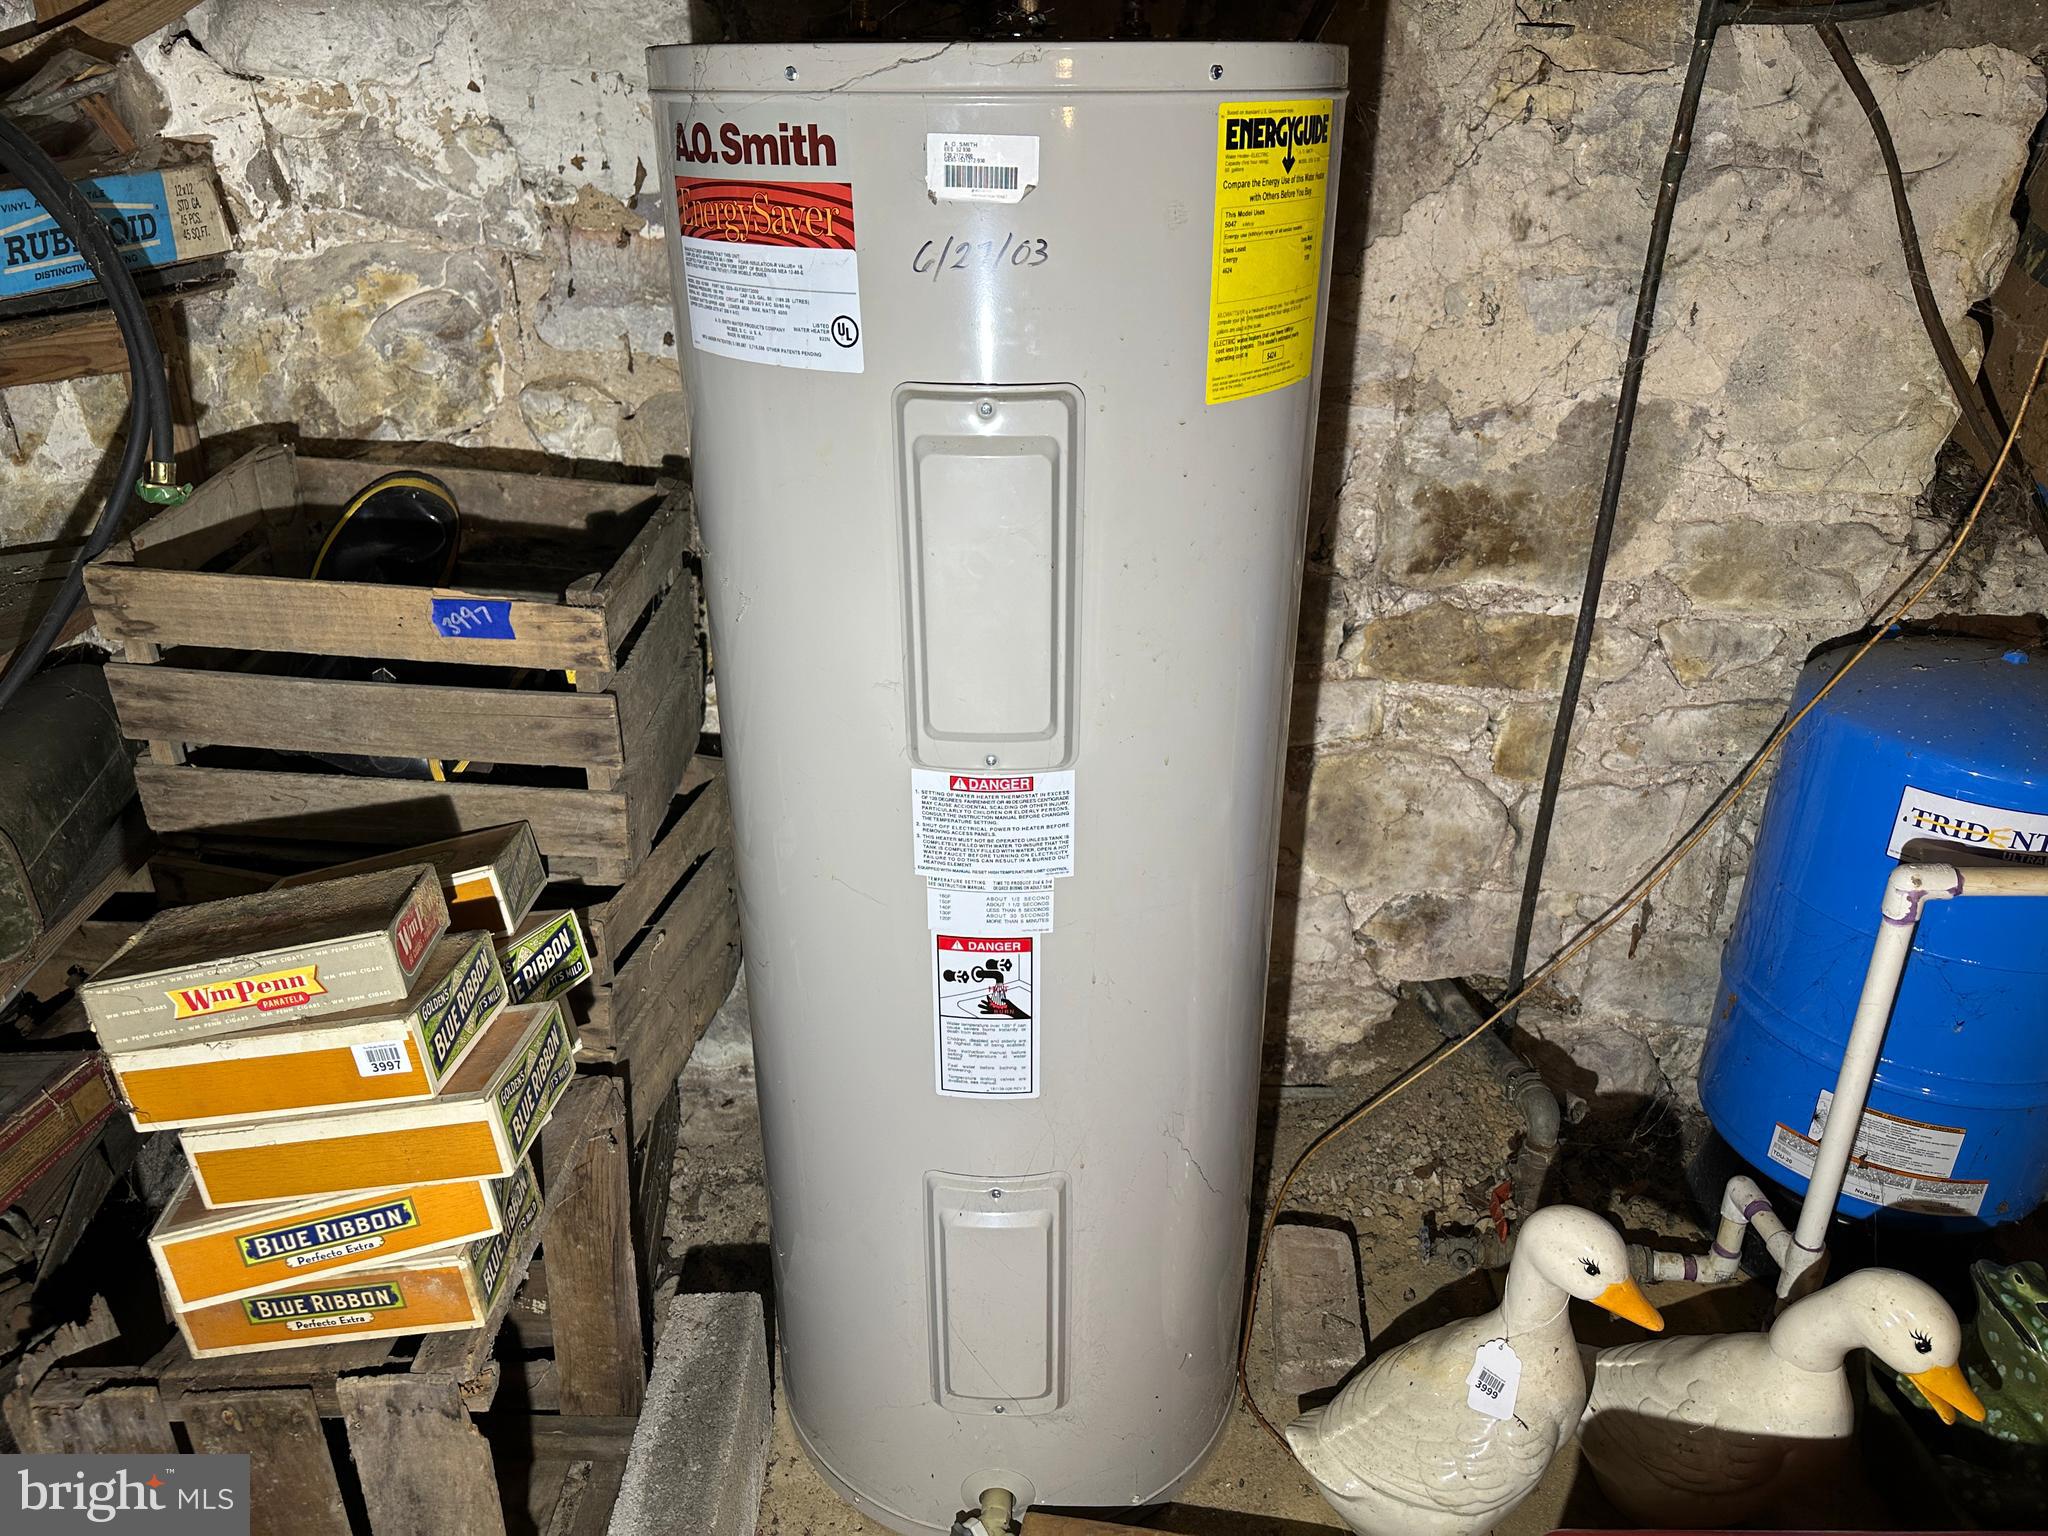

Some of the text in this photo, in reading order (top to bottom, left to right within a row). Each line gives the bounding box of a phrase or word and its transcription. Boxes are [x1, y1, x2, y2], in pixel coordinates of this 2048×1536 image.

[676, 122, 836, 166] A.O. Smith
[87, 190, 106, 198] TILE
[175, 183, 194, 196] 12x12
[1223, 180, 1250, 190] Compare
[1252, 178, 1260, 187] the
[1262, 178, 1280, 188] Energy
[1281, 176, 1290, 184] Use
[0, 201, 31, 213] VINYL
[1250, 192, 1261, 202] with
[1262, 191, 1280, 200] Others
[1281, 190, 1295, 198] Before
[181, 214, 188, 226] 45
[679, 187, 840, 243] EnergySaver
[4, 213, 157, 266] RUBOID
[184, 229, 191, 240] 45
[913, 232, 1048, 282] 6/27/03
[442, 606, 493, 635] 3997
[969, 778, 1030, 790] DANGER
[522, 928, 571, 989] RIBBON
[968, 941, 1021, 951] DANGER
[134, 980, 158, 989] CIGARS
[207, 967, 232, 976] CIGARS
[260, 959, 277, 968] PENN
[280, 954, 304, 963] CIGARS
[352, 941, 376, 951] CIGARS
[339, 970, 357, 978] PENN
[359, 965, 383, 976] CIGARS
[551, 961, 583, 986] IT'S MILD
[122, 1009, 140, 1018] PENN
[143, 1004, 167, 1013] CIGARS
[262, 994, 305, 1009] PANATELA
[422, 988, 450, 1021] GOLDEN'S
[434, 948, 490, 1063] BLUE RIBBON
[477, 997, 488, 1014] IT'S
[488, 985, 501, 1005] MILD
[153, 1029, 177, 1039] CIGARS
[203, 1020, 222, 1029] PENN
[225, 1015, 249, 1025] CIGARS
[276, 1006, 294, 1016] PENN
[296, 1002, 321, 1011] CIGARS
[347, 994, 365, 1002] PENN
[368, 989, 392, 1000] CIGARS
[371, 1060, 400, 1072] 3997
[550, 1060, 570, 1090] IT'S MILD
[500, 1069, 525, 1106] GOLDEN'S
[512, 1024, 561, 1144] BLUE RIBBON
[526, 1201, 537, 1222] MILD
[254, 1208, 404, 1257] BLUE RIBBON
[297, 1241, 375, 1265] Perfecto Extra
[483, 1234, 504, 1296] BLUE
[256, 1289, 391, 1318] BLUE RIBBON
[296, 1315, 365, 1330] Perfecto Extra
[1475, 1380, 1498, 1399] 3999
